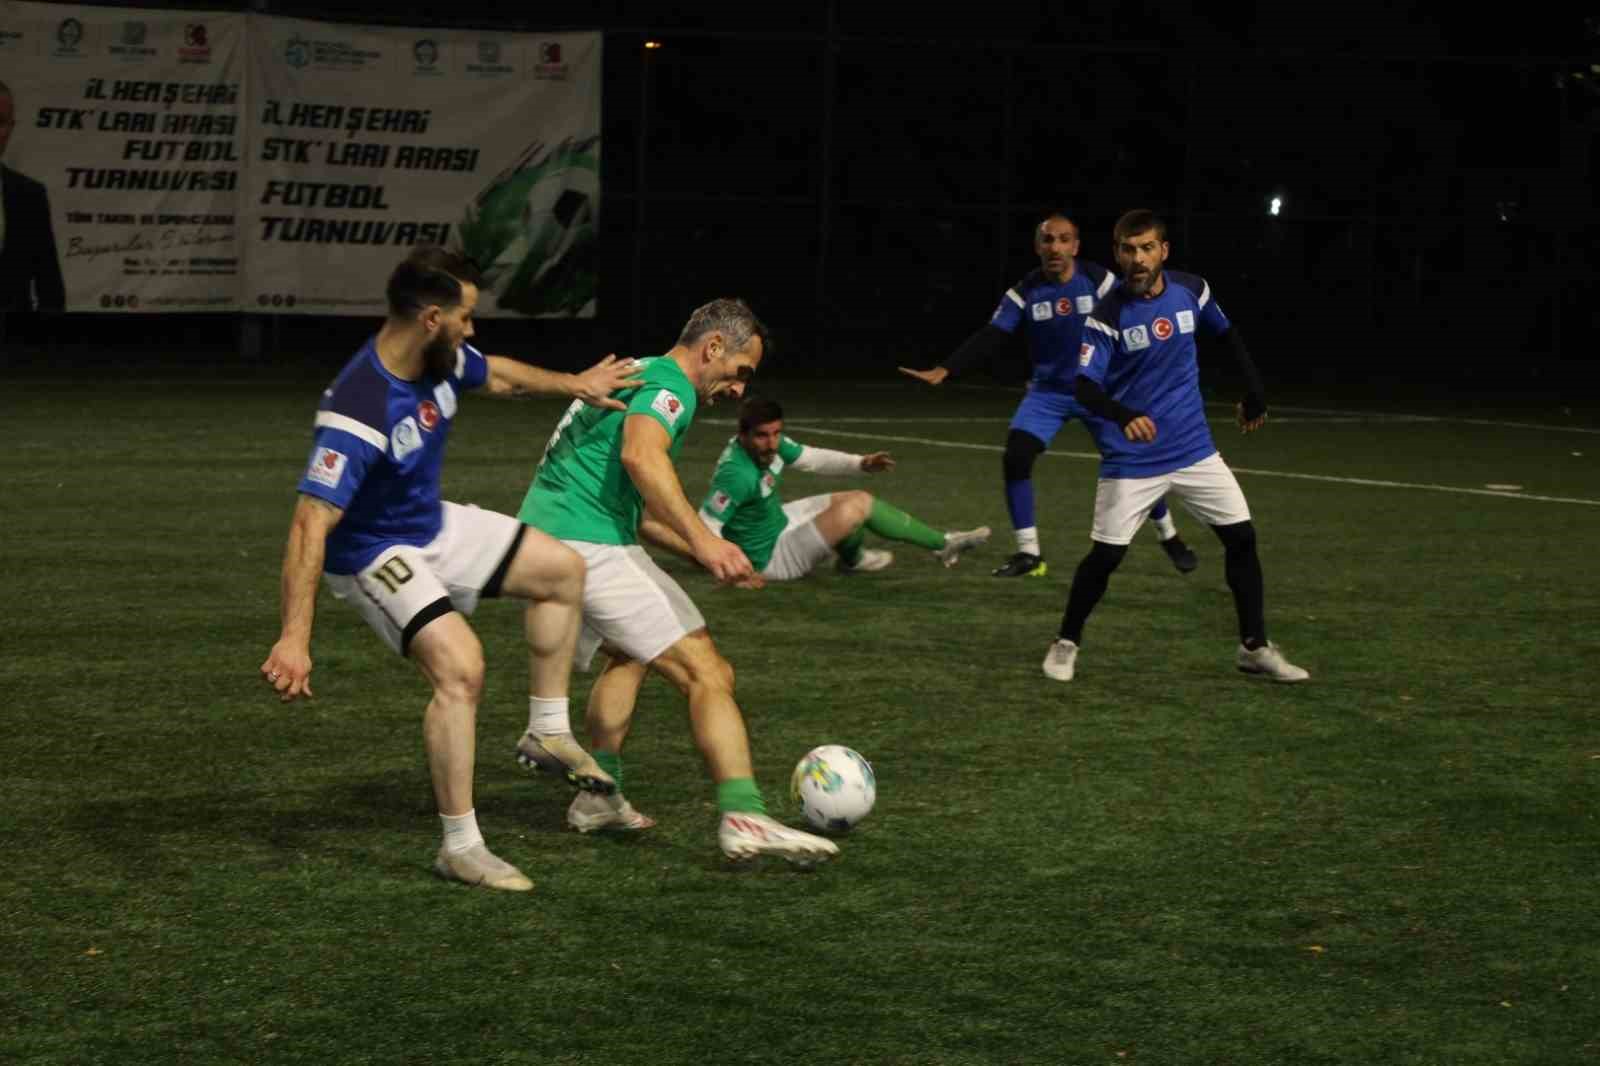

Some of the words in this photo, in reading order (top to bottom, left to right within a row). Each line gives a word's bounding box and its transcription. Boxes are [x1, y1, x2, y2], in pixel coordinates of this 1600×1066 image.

[161, 113, 239, 135] ARASI
[122, 139, 239, 162] FUTBOL
[394, 145, 481, 172] ARASI
[65, 168, 238, 191] TURNUVASI
[260, 180, 389, 210] FUTBOL
[260, 216, 451, 246] TURNUVASI
[373, 555, 414, 594] 10
